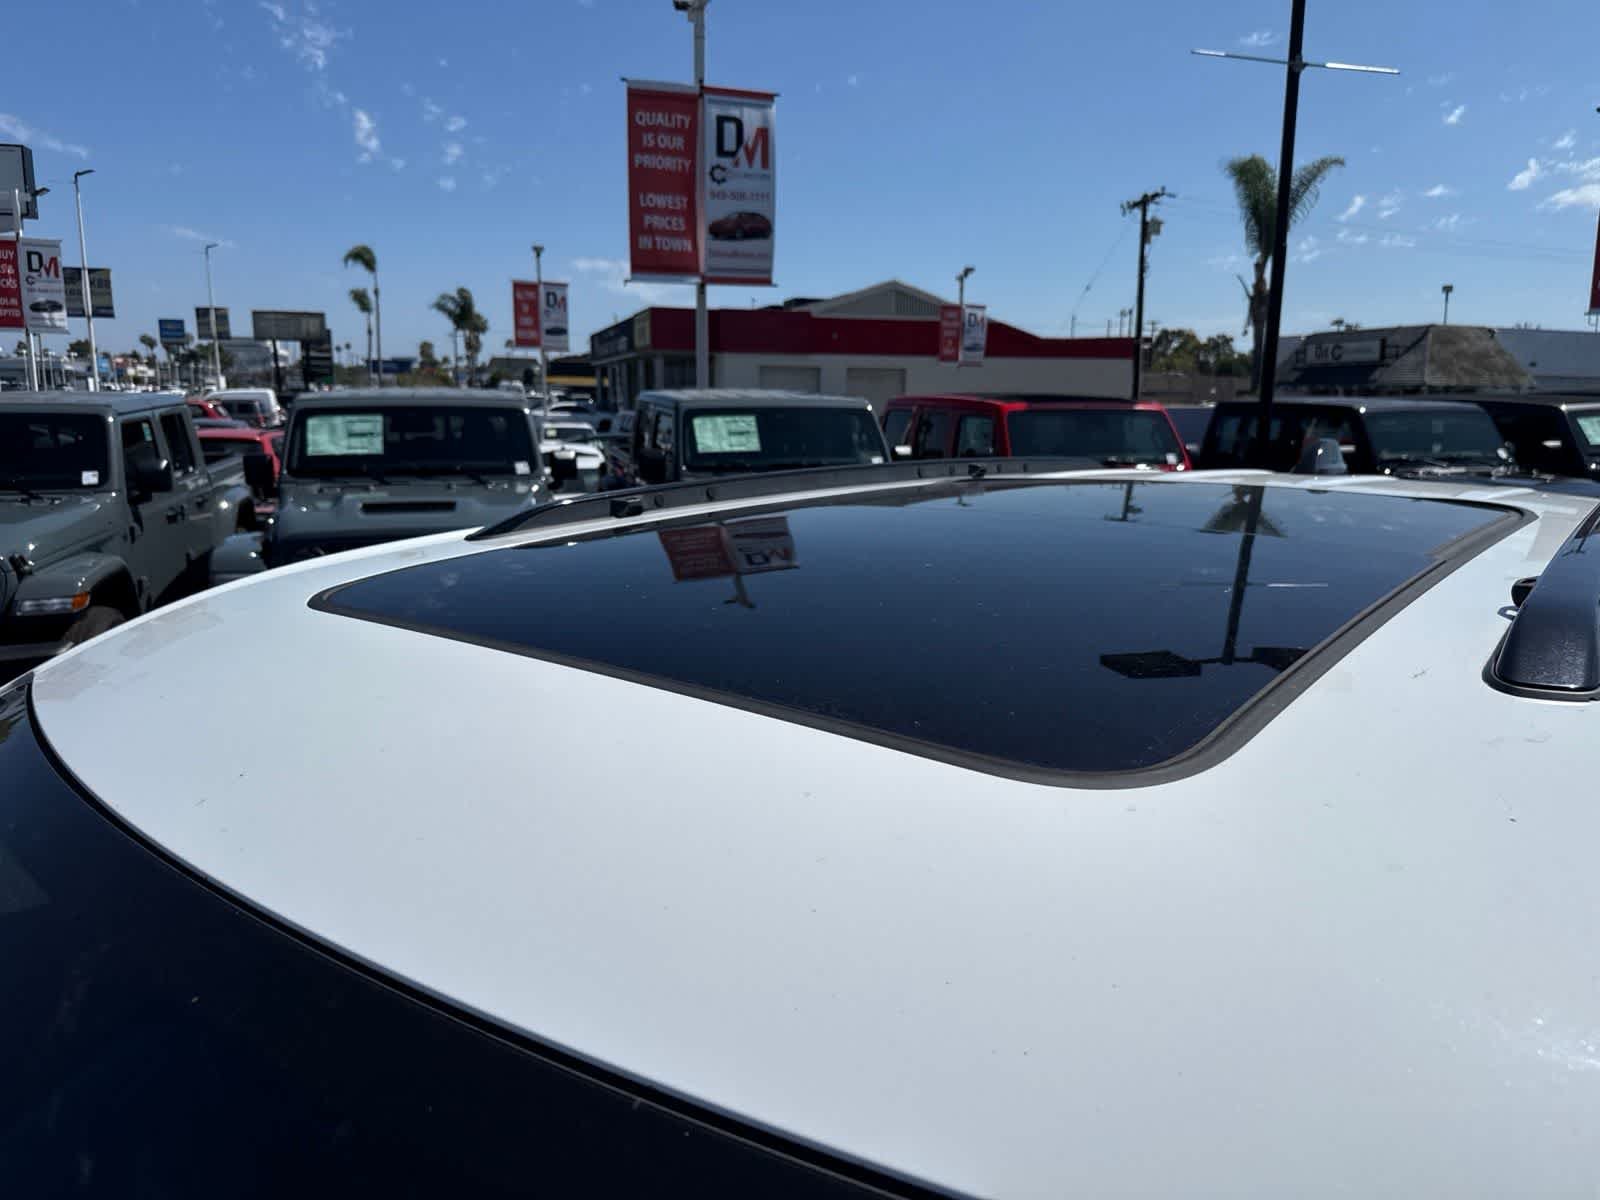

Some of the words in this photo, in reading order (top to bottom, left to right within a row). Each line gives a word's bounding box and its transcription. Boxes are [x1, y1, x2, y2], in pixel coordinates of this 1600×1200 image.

[635, 111, 691, 129] QUALITY
[642, 132, 655, 147] IS
[657, 134, 685, 150] OUR
[634, 153, 692, 173] PRIORITY
[639, 191, 689, 210] LOWEST
[643, 213, 687, 232] PRICES
[637, 234, 653, 250] IN
[655, 235, 693, 252] TOWN
[0, 249, 14, 260] UY
